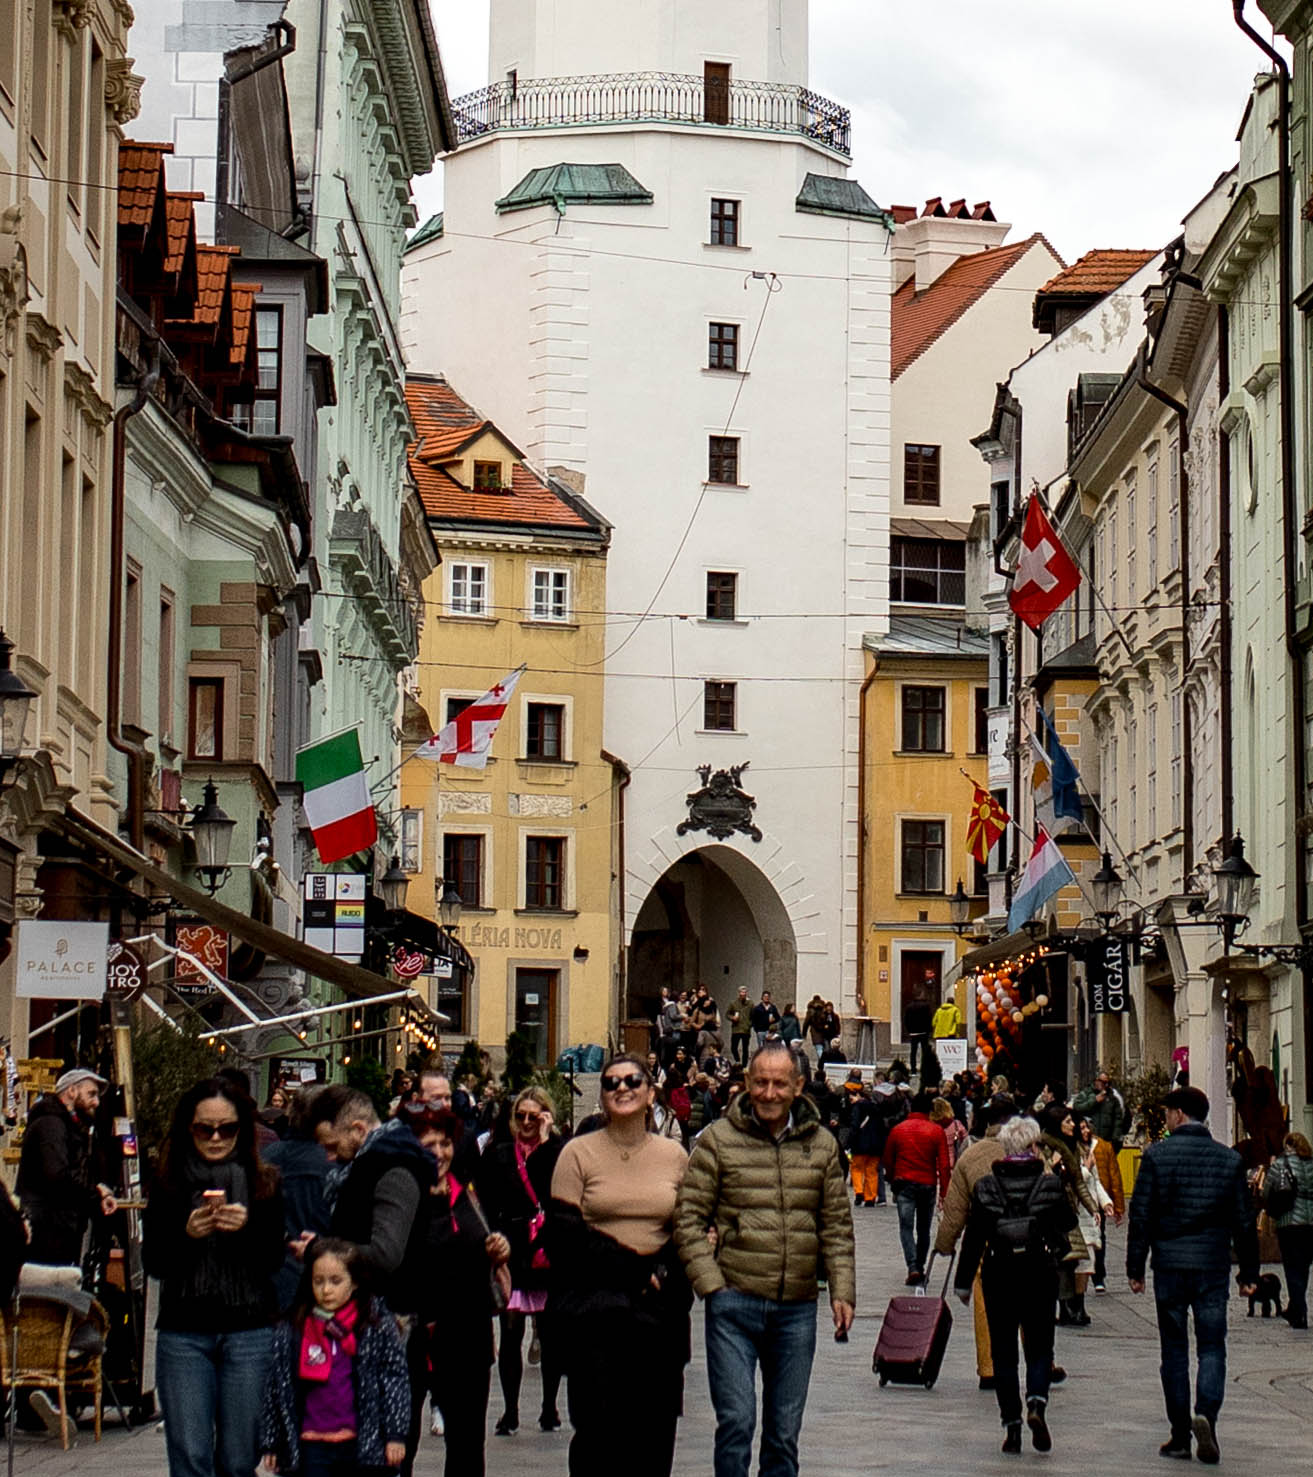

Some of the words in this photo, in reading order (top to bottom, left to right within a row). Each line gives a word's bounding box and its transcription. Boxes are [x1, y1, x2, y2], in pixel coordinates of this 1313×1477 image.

[461, 921, 510, 948] LÉRIA
[515, 928, 562, 949] NOVA
[26, 960, 96, 974] PALACE
[107, 964, 140, 977] JOY
[107, 976, 141, 988] TRO
[1102, 943, 1124, 1011] CIGÁR
[1093, 984, 1104, 1011] DOM
[943, 1044, 961, 1054] WC
